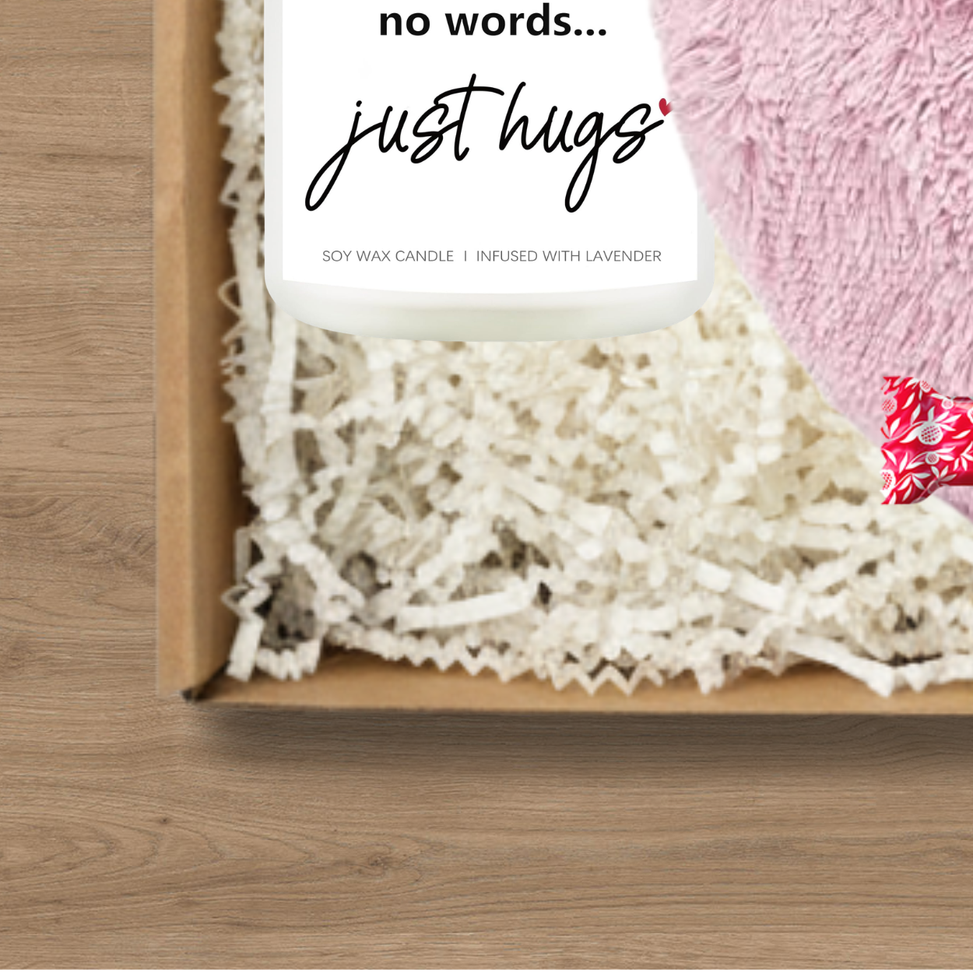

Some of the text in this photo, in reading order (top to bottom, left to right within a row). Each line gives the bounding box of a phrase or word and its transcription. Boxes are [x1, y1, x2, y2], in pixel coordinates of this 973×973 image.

[379, 1, 607, 37] no words...
[304, 72, 665, 214] just hugs
[322, 249, 352, 263] SOY
[355, 249, 391, 263] WAX
[395, 249, 454, 263] CANDLE
[476, 249, 538, 263] INFUSED
[542, 249, 581, 263] WITH
[586, 249, 662, 263] LAVENDER
